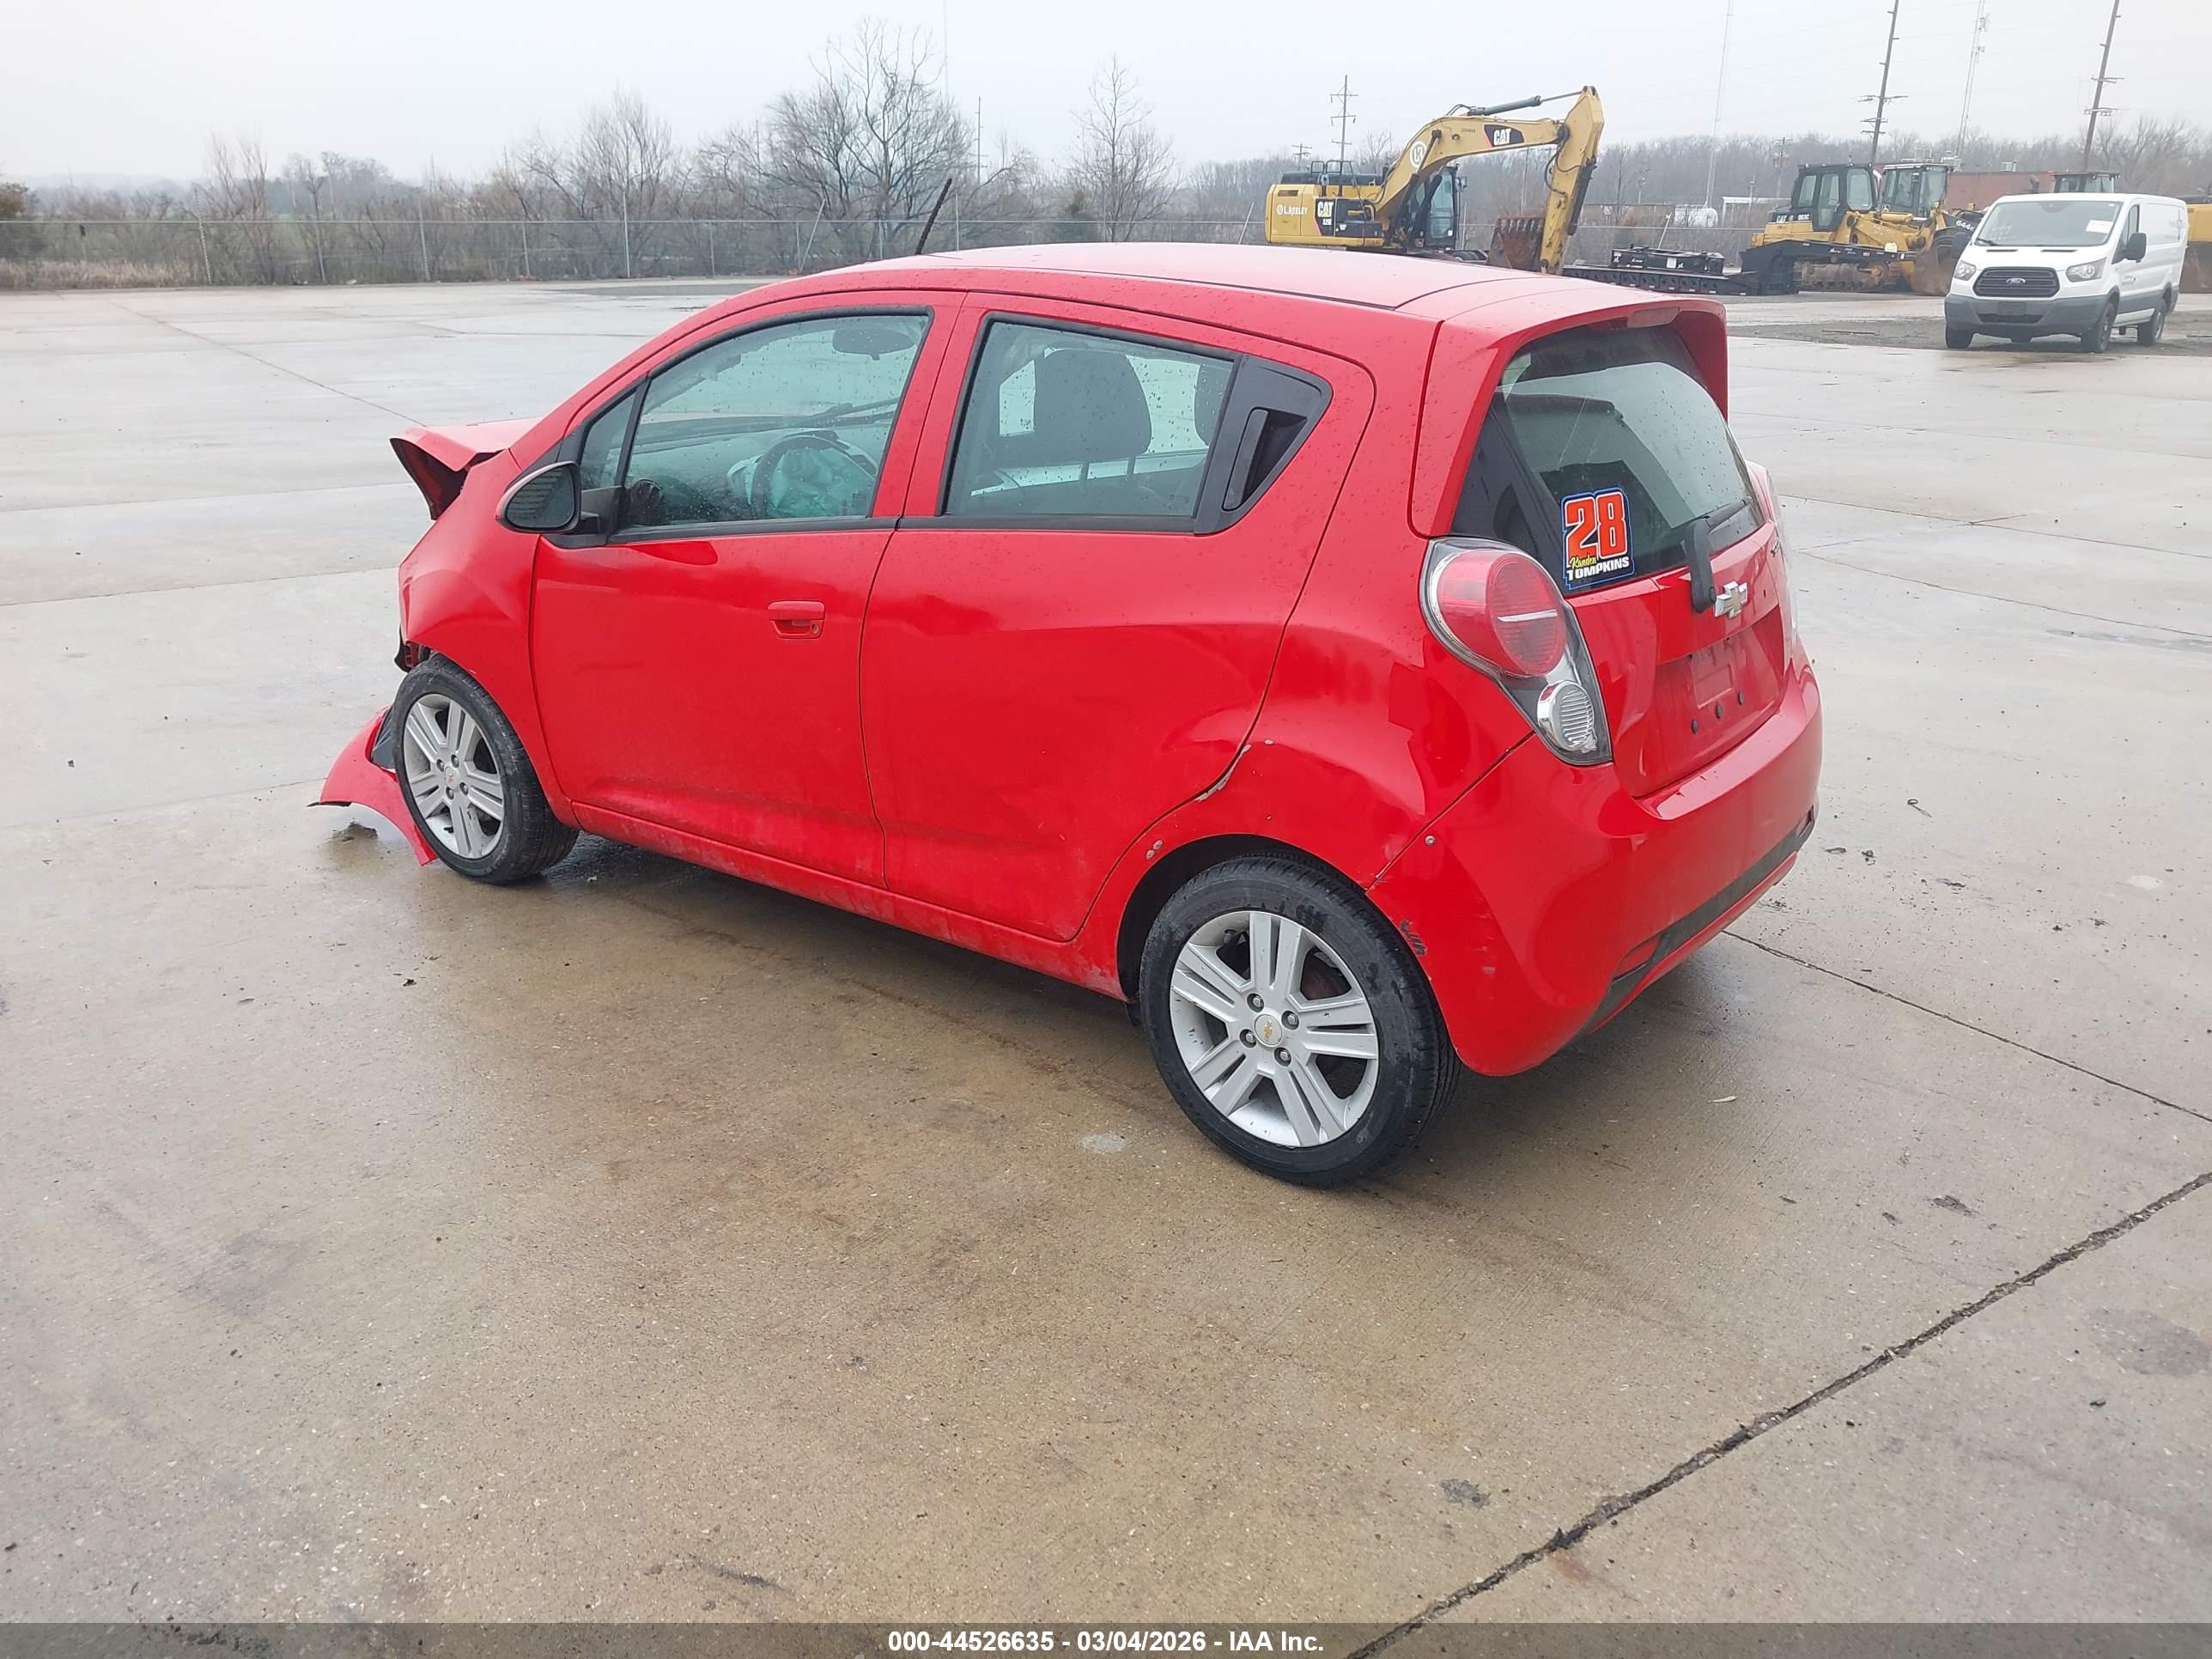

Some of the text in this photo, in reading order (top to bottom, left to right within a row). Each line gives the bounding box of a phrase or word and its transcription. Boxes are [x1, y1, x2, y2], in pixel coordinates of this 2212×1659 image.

[1493, 128, 1511, 146] CAT
[1317, 201, 1334, 218] CAT
[1565, 491, 1628, 568] 28
[1566, 556, 1631, 581] TOMPKINS
